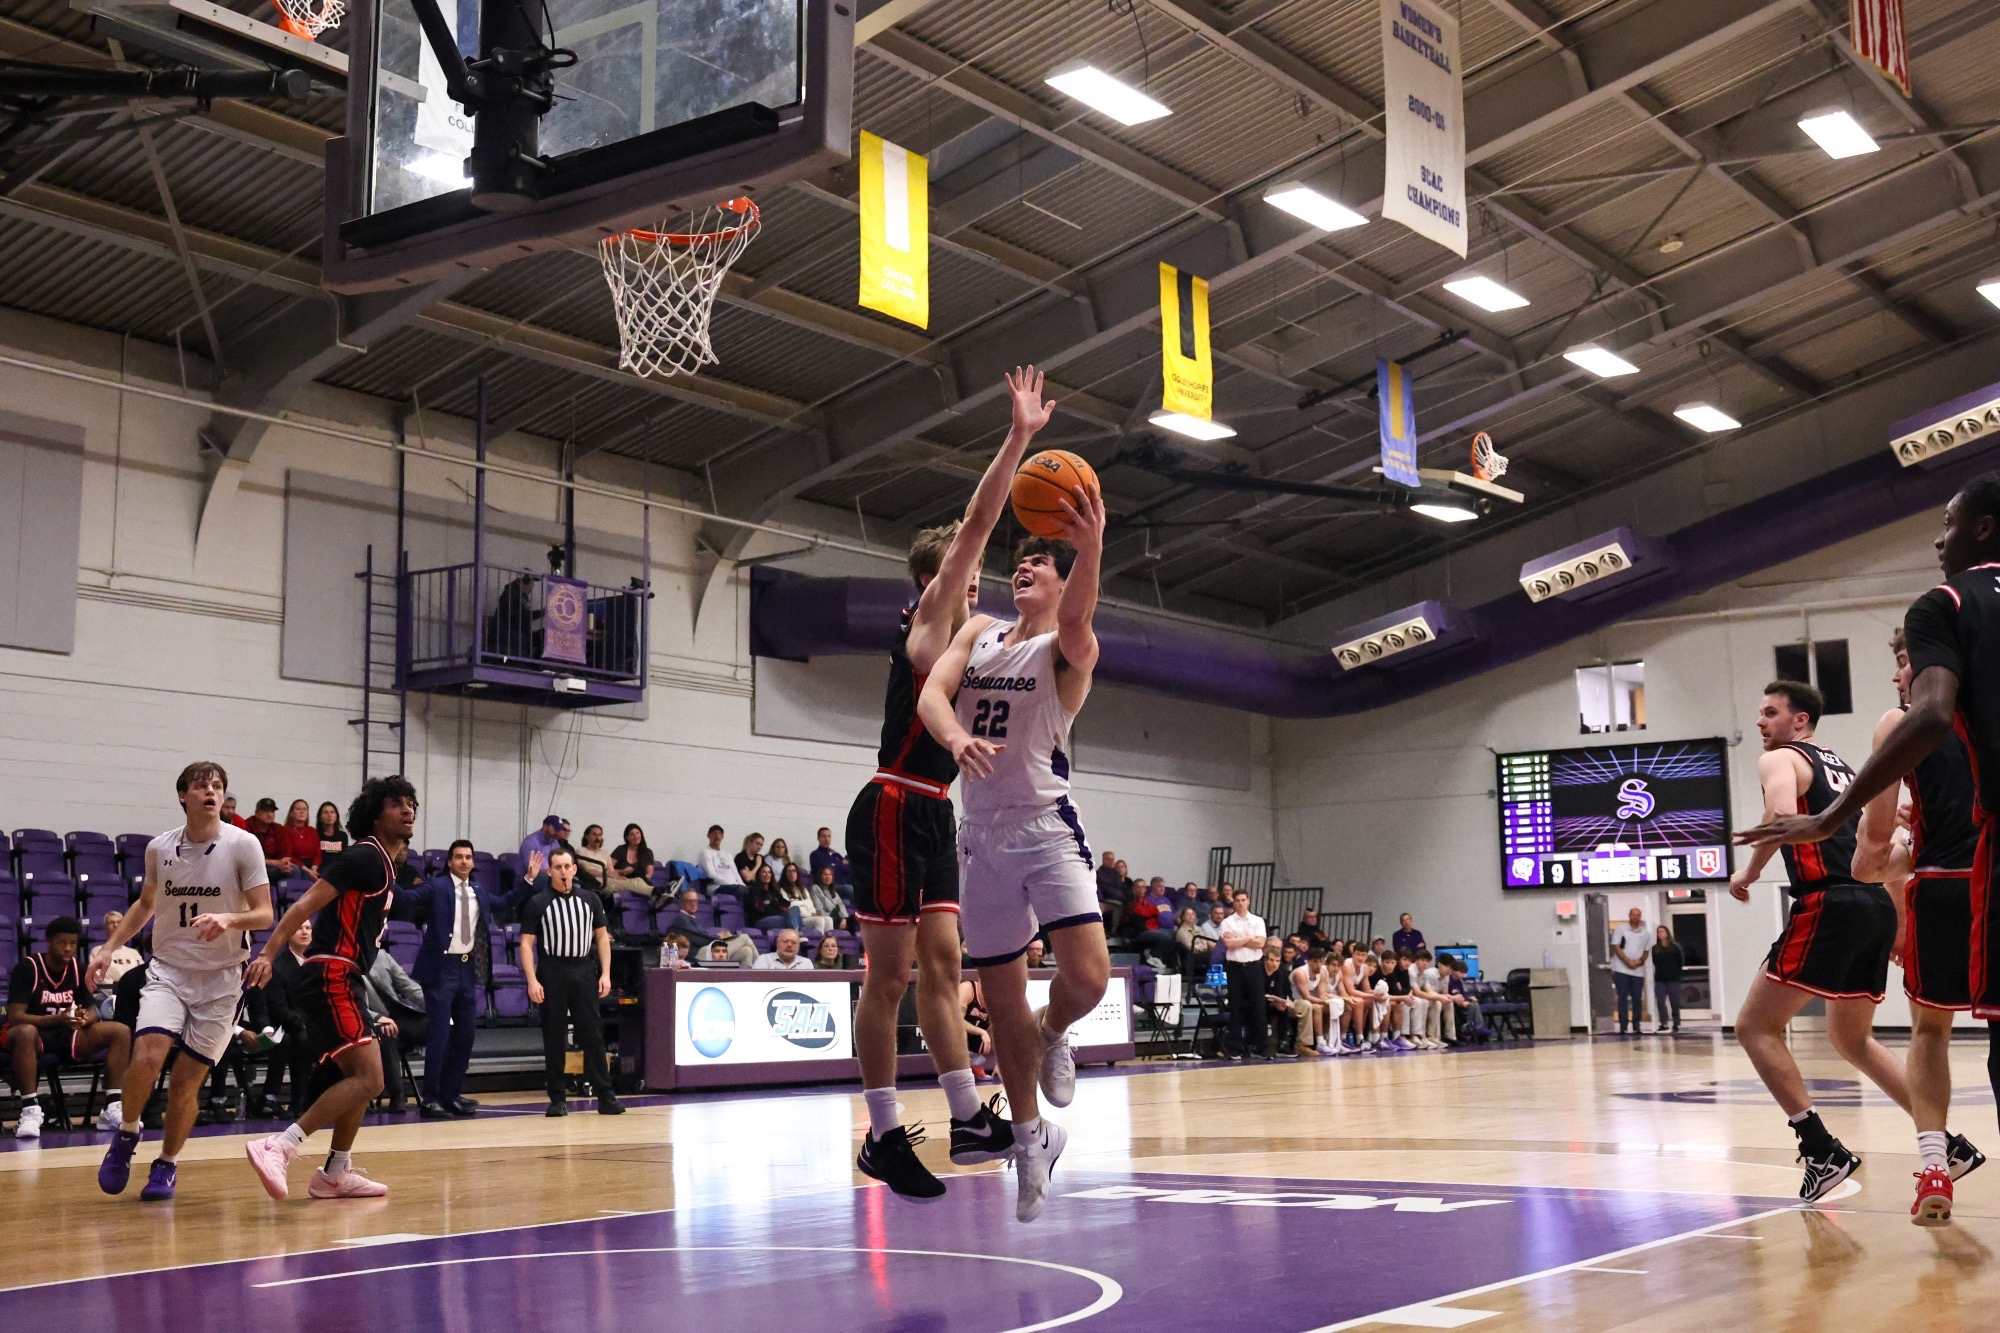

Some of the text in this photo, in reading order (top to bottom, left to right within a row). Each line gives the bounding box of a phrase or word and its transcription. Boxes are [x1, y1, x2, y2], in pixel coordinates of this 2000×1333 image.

[1393, 20, 1451, 74] BASKETBALL
[1407, 184, 1460, 228] CHAMPIONS
[961, 666, 1037, 692] Sewanee
[972, 699, 1010, 738] 22
[1551, 864, 1565, 883] 9
[1661, 859, 1681, 879] 15
[165, 880, 221, 896] Sewanee
[179, 902, 198, 928] 11
[772, 1000, 834, 1039] SAA
